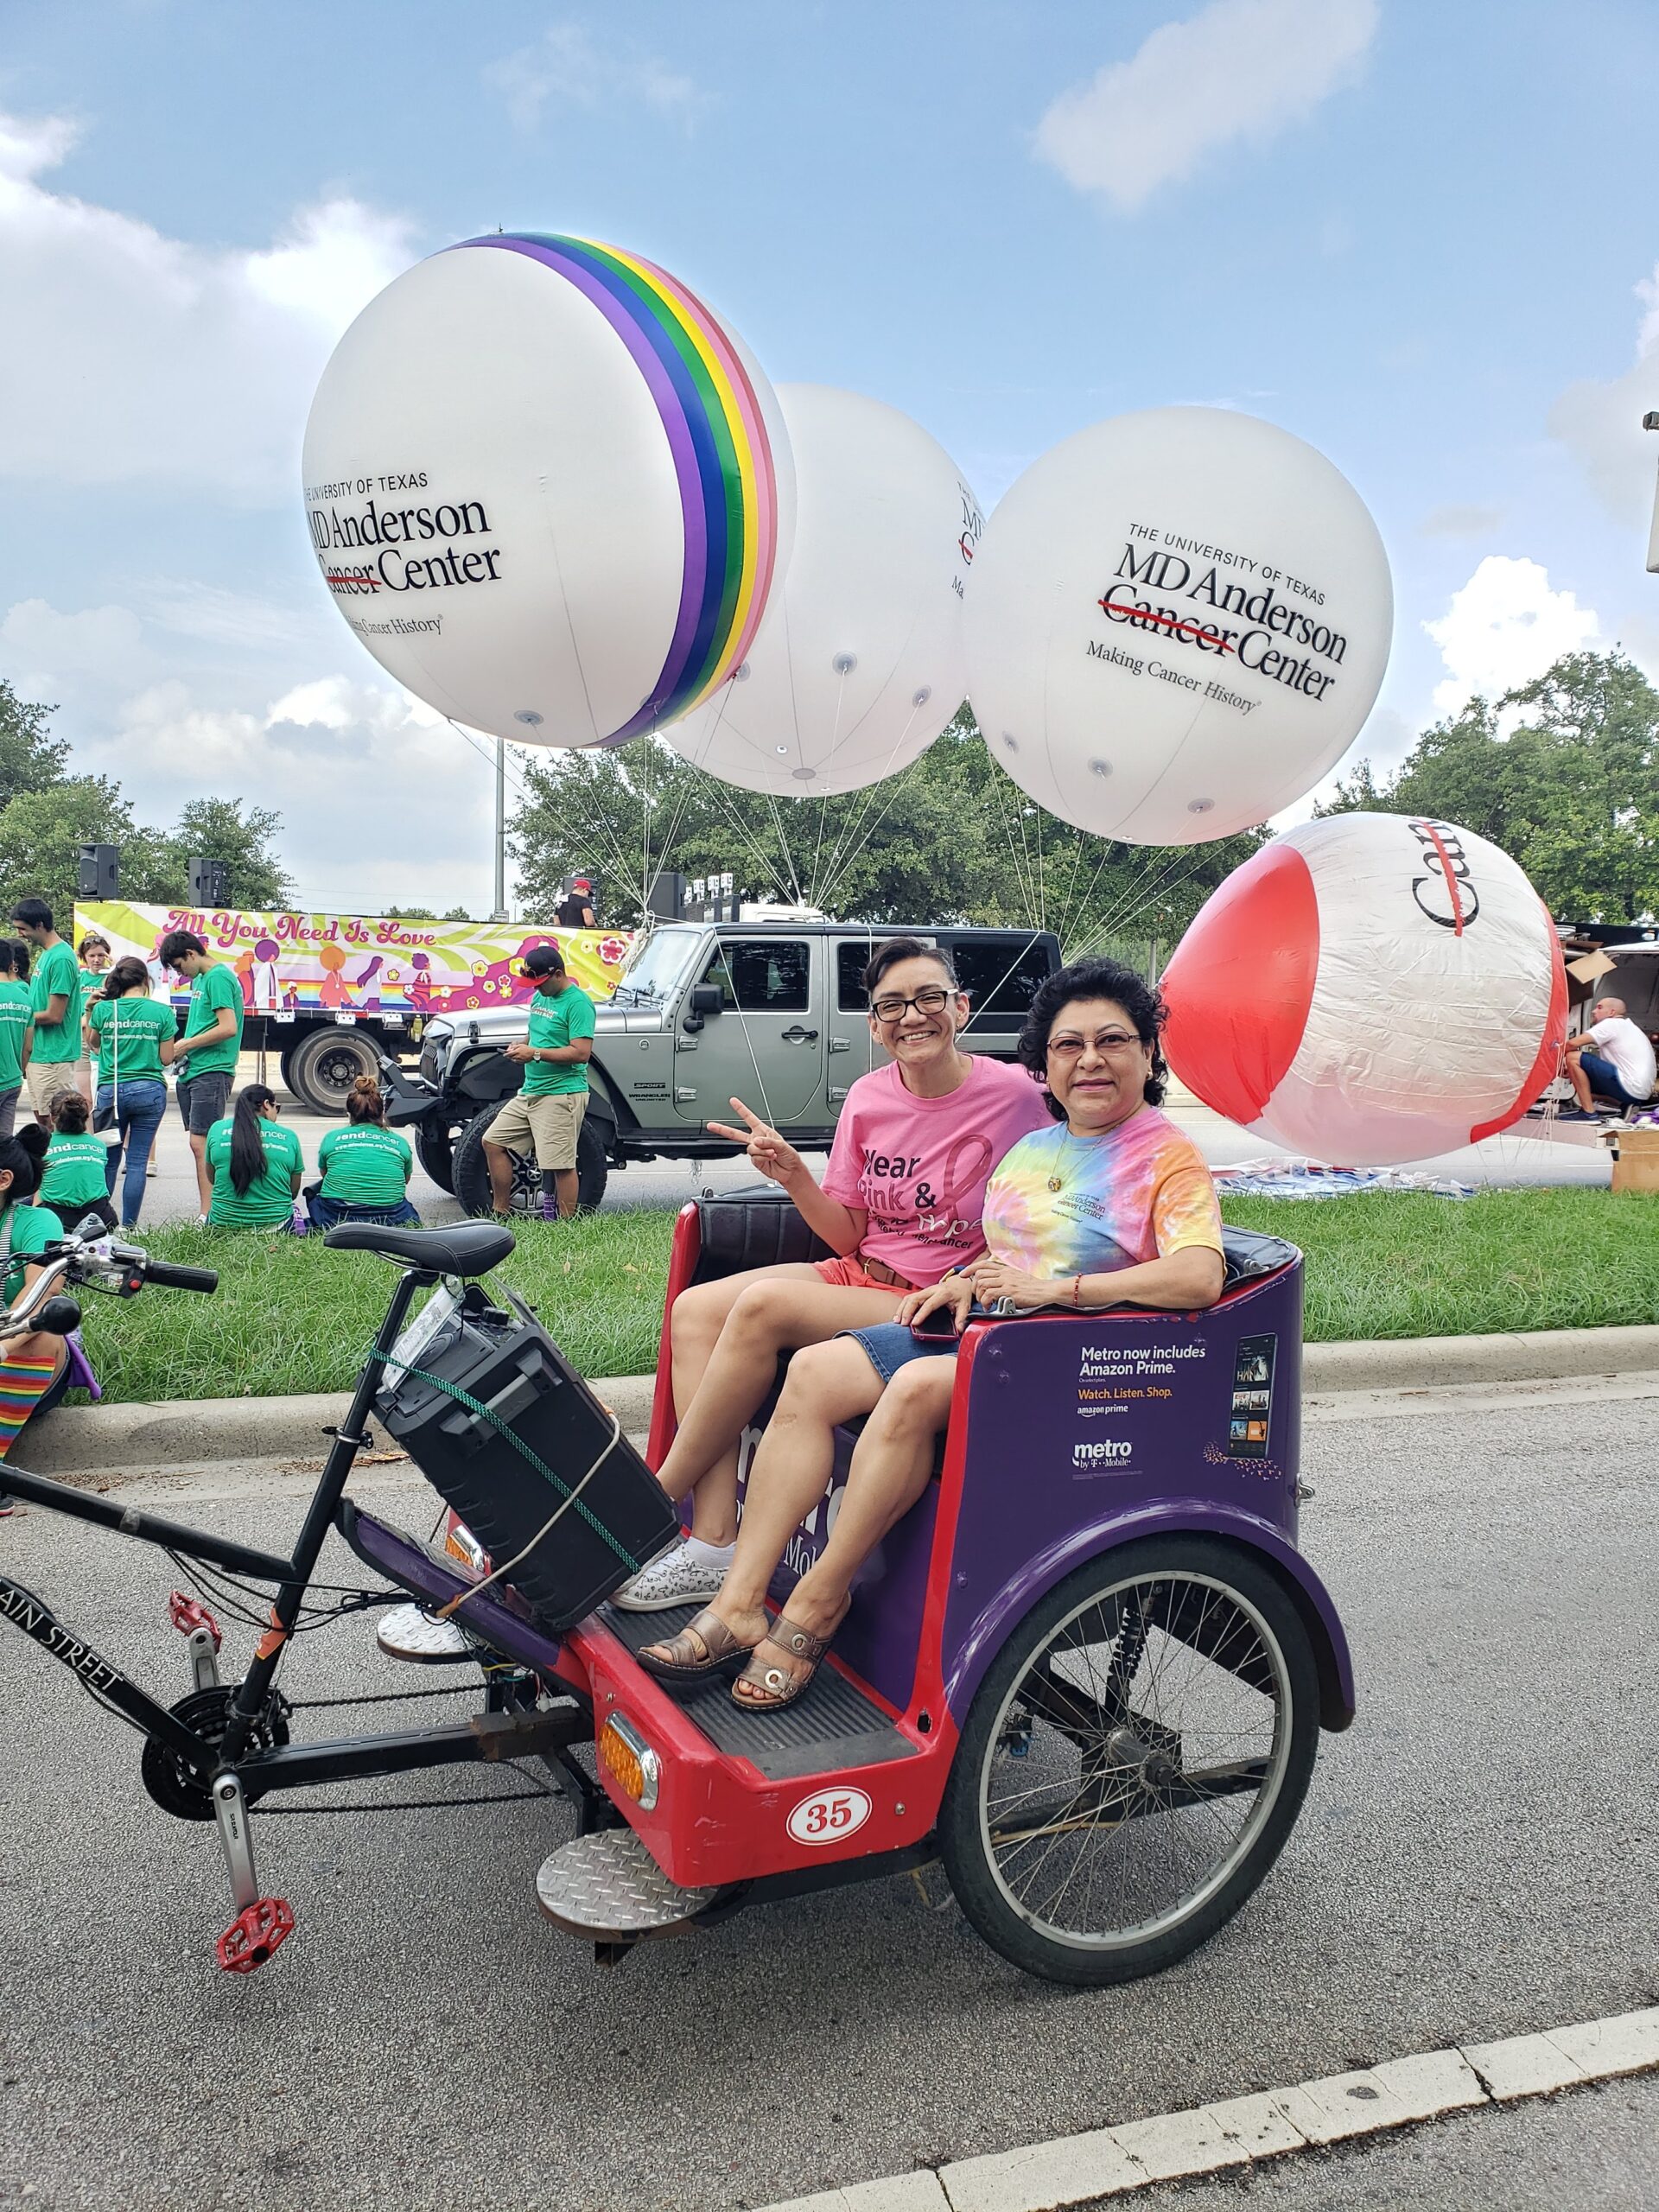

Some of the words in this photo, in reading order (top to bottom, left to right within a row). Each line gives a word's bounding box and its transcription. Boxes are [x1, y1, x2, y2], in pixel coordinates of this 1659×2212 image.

[312, 480, 353, 501] UNIVERSITY
[356, 478, 373, 494] OF
[378, 472, 428, 492] TEXAS
[332, 499, 493, 549] Anderson
[377, 547, 502, 591] Center
[1128, 523, 1160, 542] THE
[1164, 532, 1259, 574] UNIVERSITY
[1261, 566, 1282, 583] OF
[1286, 575, 1326, 607] TEXAS
[1113, 543, 1192, 592] MD
[1185, 567, 1348, 665] Anderson
[1101, 583, 1239, 658] Cancer
[1237, 629, 1336, 702] Center
[1086, 640, 1145, 676] Making
[1147, 661, 1202, 692] Cancer
[162, 910, 206, 935] All
[211, 912, 270, 949] You
[275, 915, 339, 942] Need
[344, 919, 370, 944] Is
[376, 920, 437, 946] Love
[914, 1182, 938, 1209] &
[1072, 1196, 1106, 1213] Anderson
[1078, 1205, 1103, 1221] Center
[1081, 1346, 1122, 1361] Metro
[1123, 1347, 1151, 1360] now
[1153, 1344, 1206, 1359] includes
[1079, 1362, 1134, 1376] Amazon
[1136, 1360, 1176, 1375] Prime.
[1077, 1388, 1112, 1400] Watch.
[1114, 1387, 1145, 1399] Listen.
[1147, 1386, 1173, 1399] Shop.
[1077, 1406, 1104, 1414] amazon
[1105, 1403, 1128, 1414] prime
[1074, 1439, 1132, 1459] metro
[1080, 1459, 1090, 1471] by
[39, 1626, 124, 1691] STREET
[806, 1797, 852, 1834] 35
